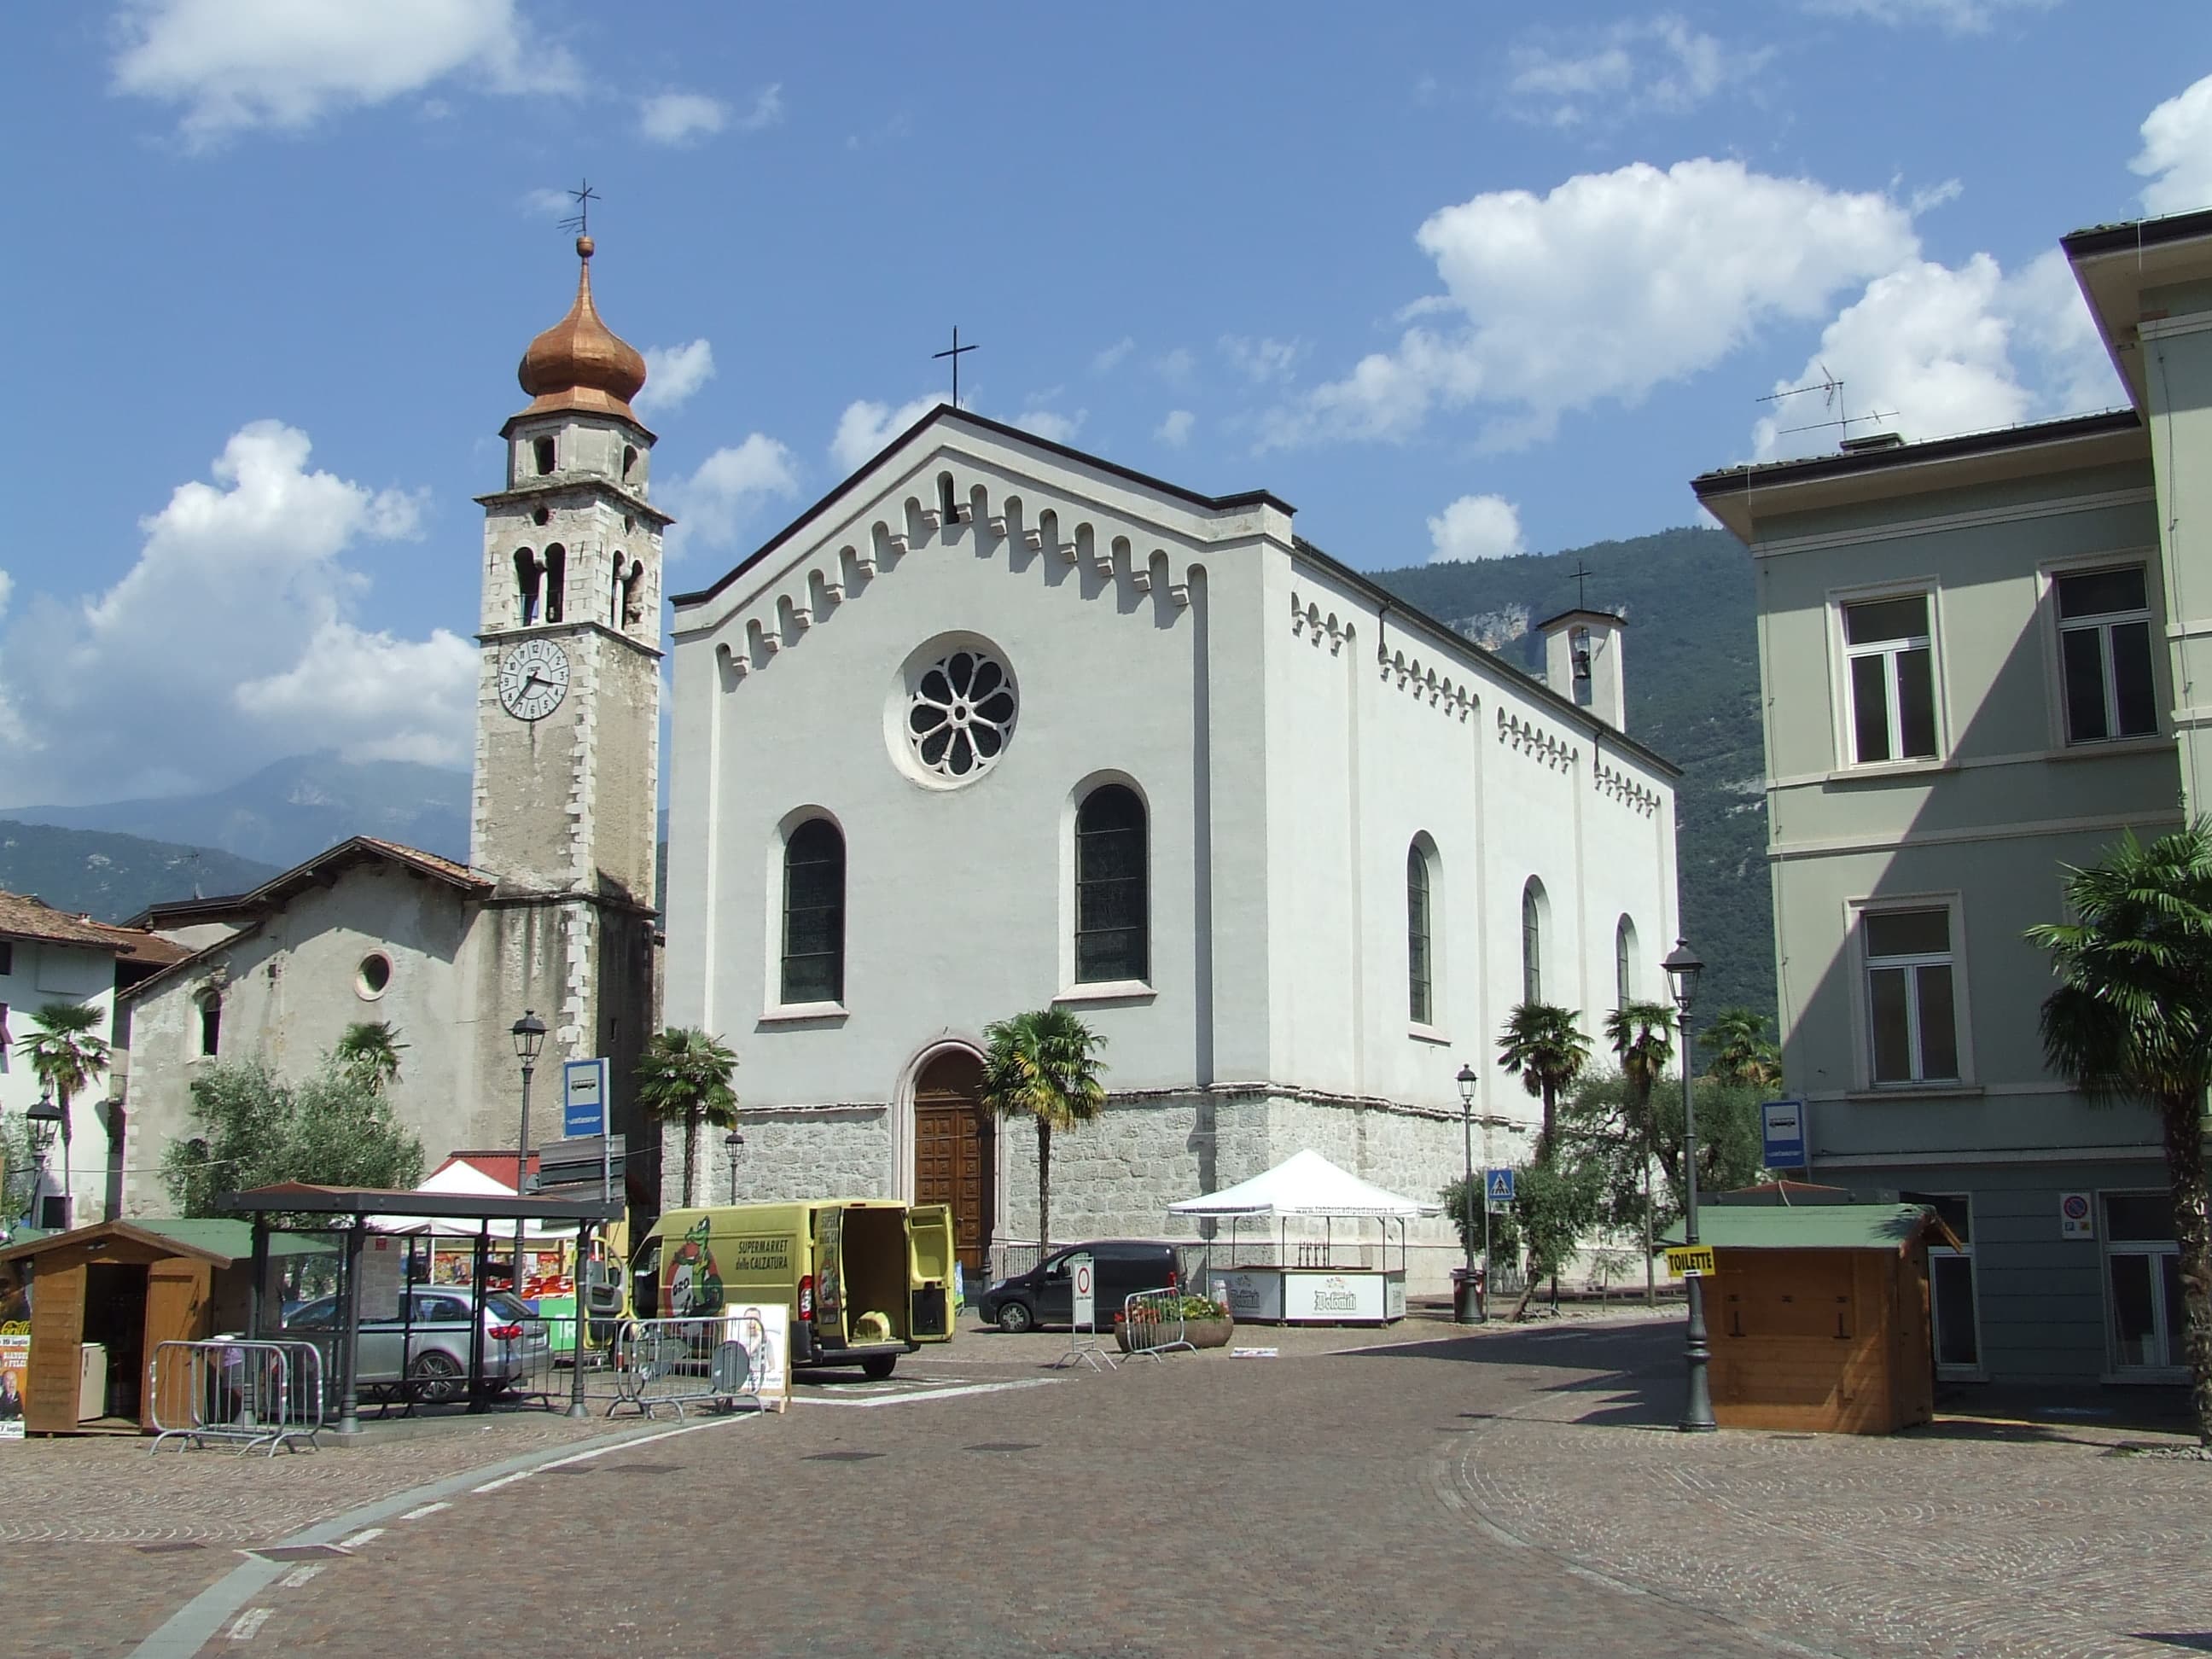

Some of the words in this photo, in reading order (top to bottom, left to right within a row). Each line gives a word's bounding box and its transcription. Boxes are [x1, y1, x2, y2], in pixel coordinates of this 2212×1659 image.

[738, 1239, 788, 1254] SUPERMARKET
[735, 1256, 749, 1271] della
[750, 1255, 789, 1270] CALZATURA
[1668, 1252, 1713, 1271] TOILETTE
[1313, 1290, 1357, 1312] Dolomiti
